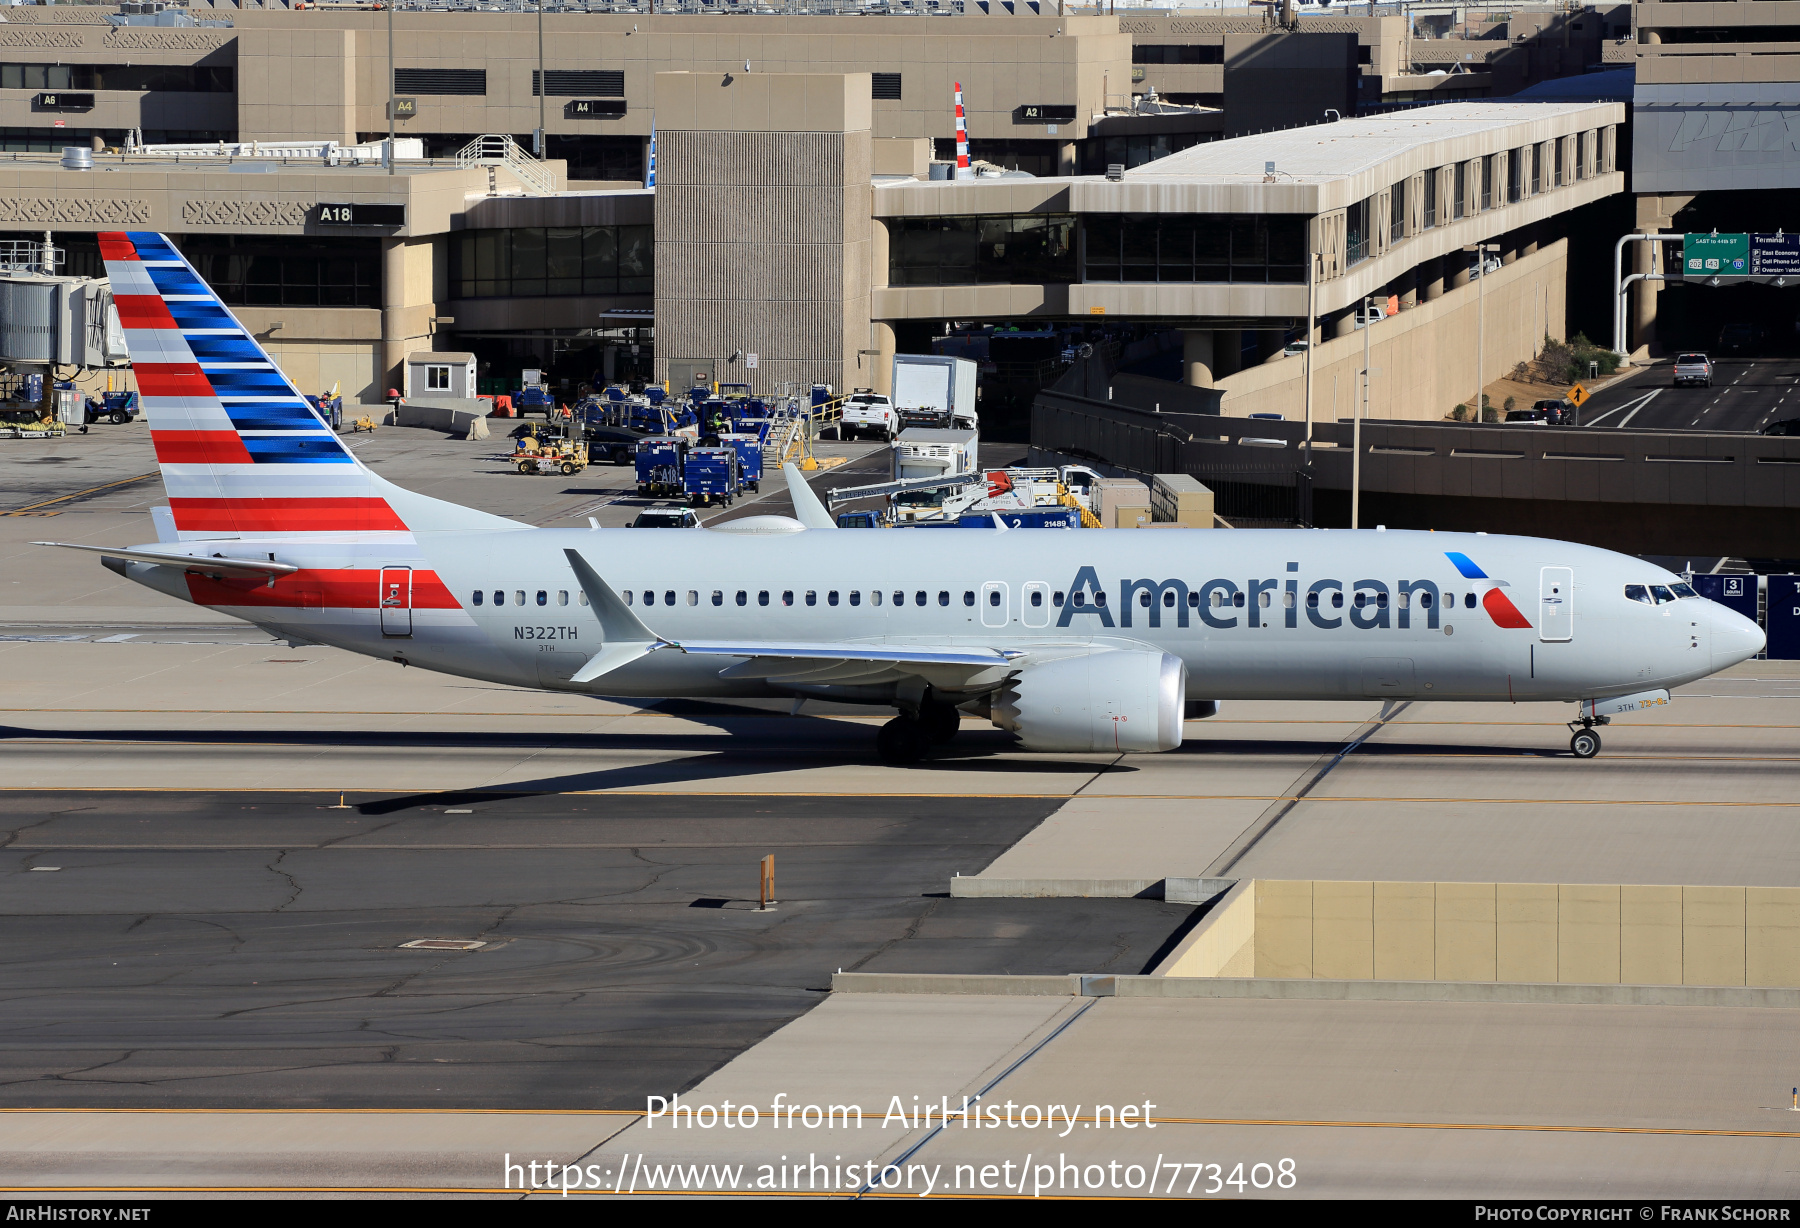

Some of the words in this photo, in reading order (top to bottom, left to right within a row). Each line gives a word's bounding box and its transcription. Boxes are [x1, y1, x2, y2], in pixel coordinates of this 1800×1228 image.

[1132, 69, 1143, 77] B2
[44, 95, 56, 105] A6
[397, 101, 414, 112] A4
[577, 102, 589, 112] A4
[1025, 107, 1038, 117] A2
[320, 207, 351, 221] A18
[661, 468, 677, 483] A18
[1012, 518, 1022, 528] 2
[1044, 520, 1067, 528] 21489
[1729, 580, 1738, 590] 3
[1055, 561, 1440, 630] American
[514, 626, 578, 640] N322TH
[538, 644, 555, 652] 3TH
[1617, 703, 1634, 712] 3TH
